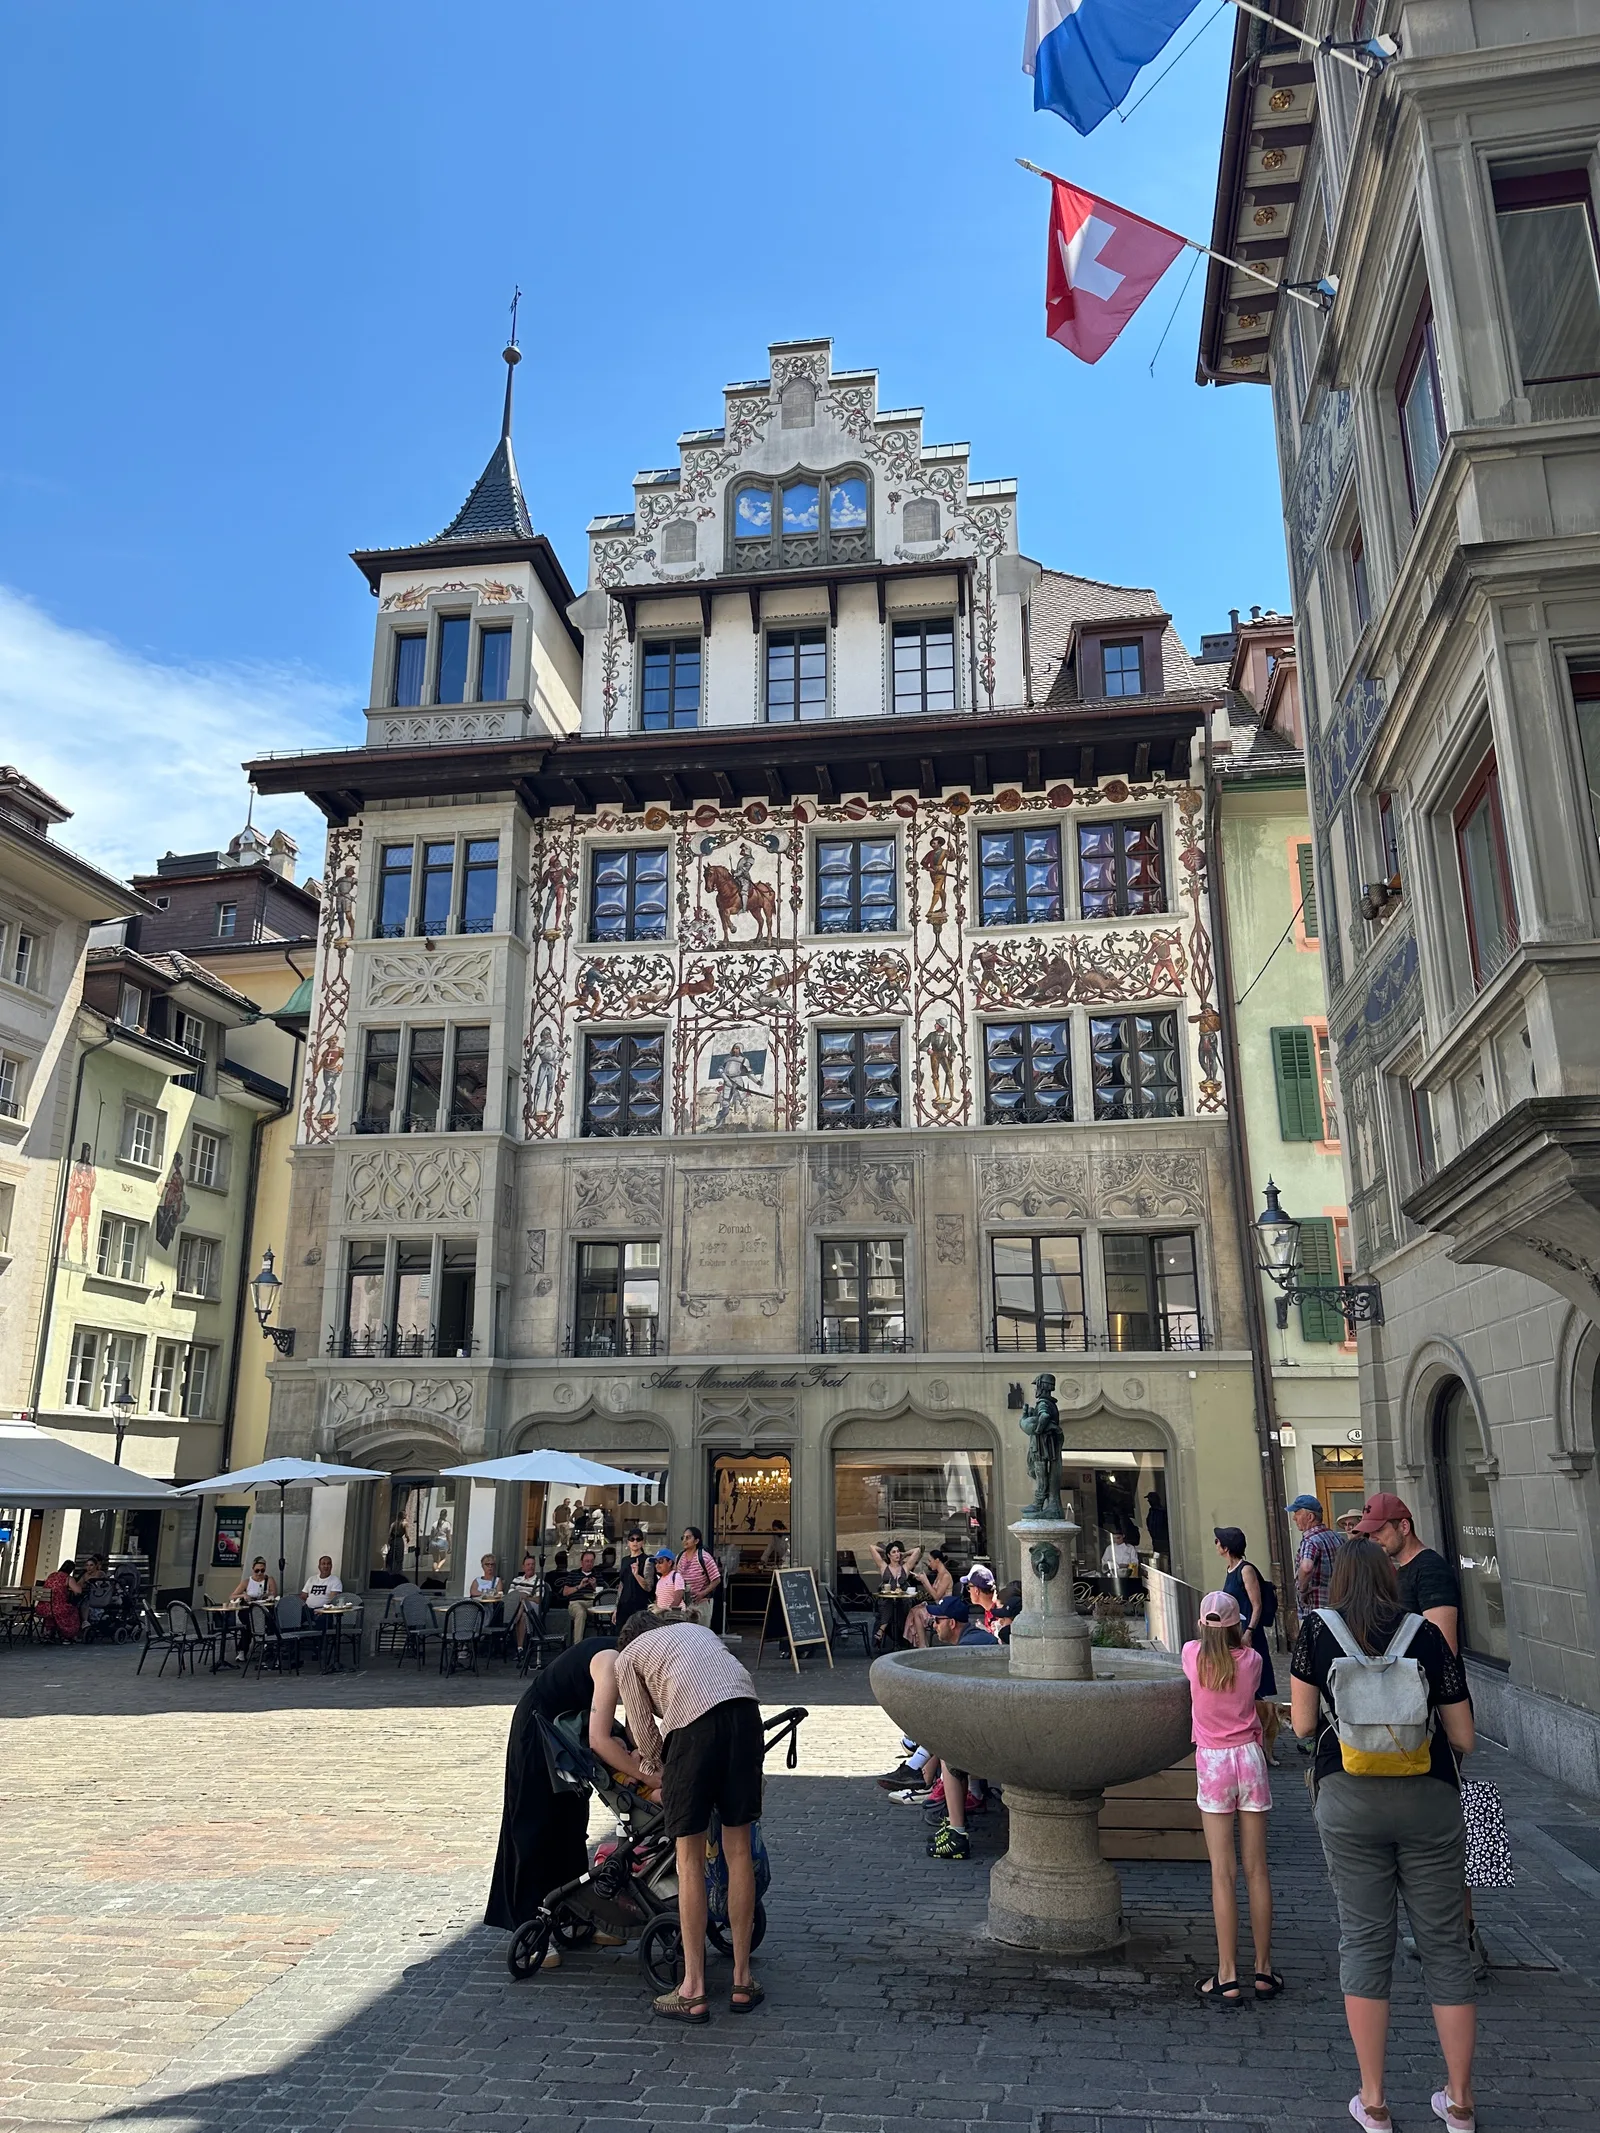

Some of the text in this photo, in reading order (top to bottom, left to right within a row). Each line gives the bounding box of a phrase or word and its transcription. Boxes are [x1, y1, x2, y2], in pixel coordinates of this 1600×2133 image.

[718, 1222, 752, 1235] Dornach
[642, 1365, 852, 1390] Aux Merveilleux de Fred
[1354, 1430, 1361, 1439] 8
[1462, 1525, 1475, 1535] FACE
[1475, 1526, 1487, 1537] YOUR
[1072, 1581, 1126, 1610] Depuis
